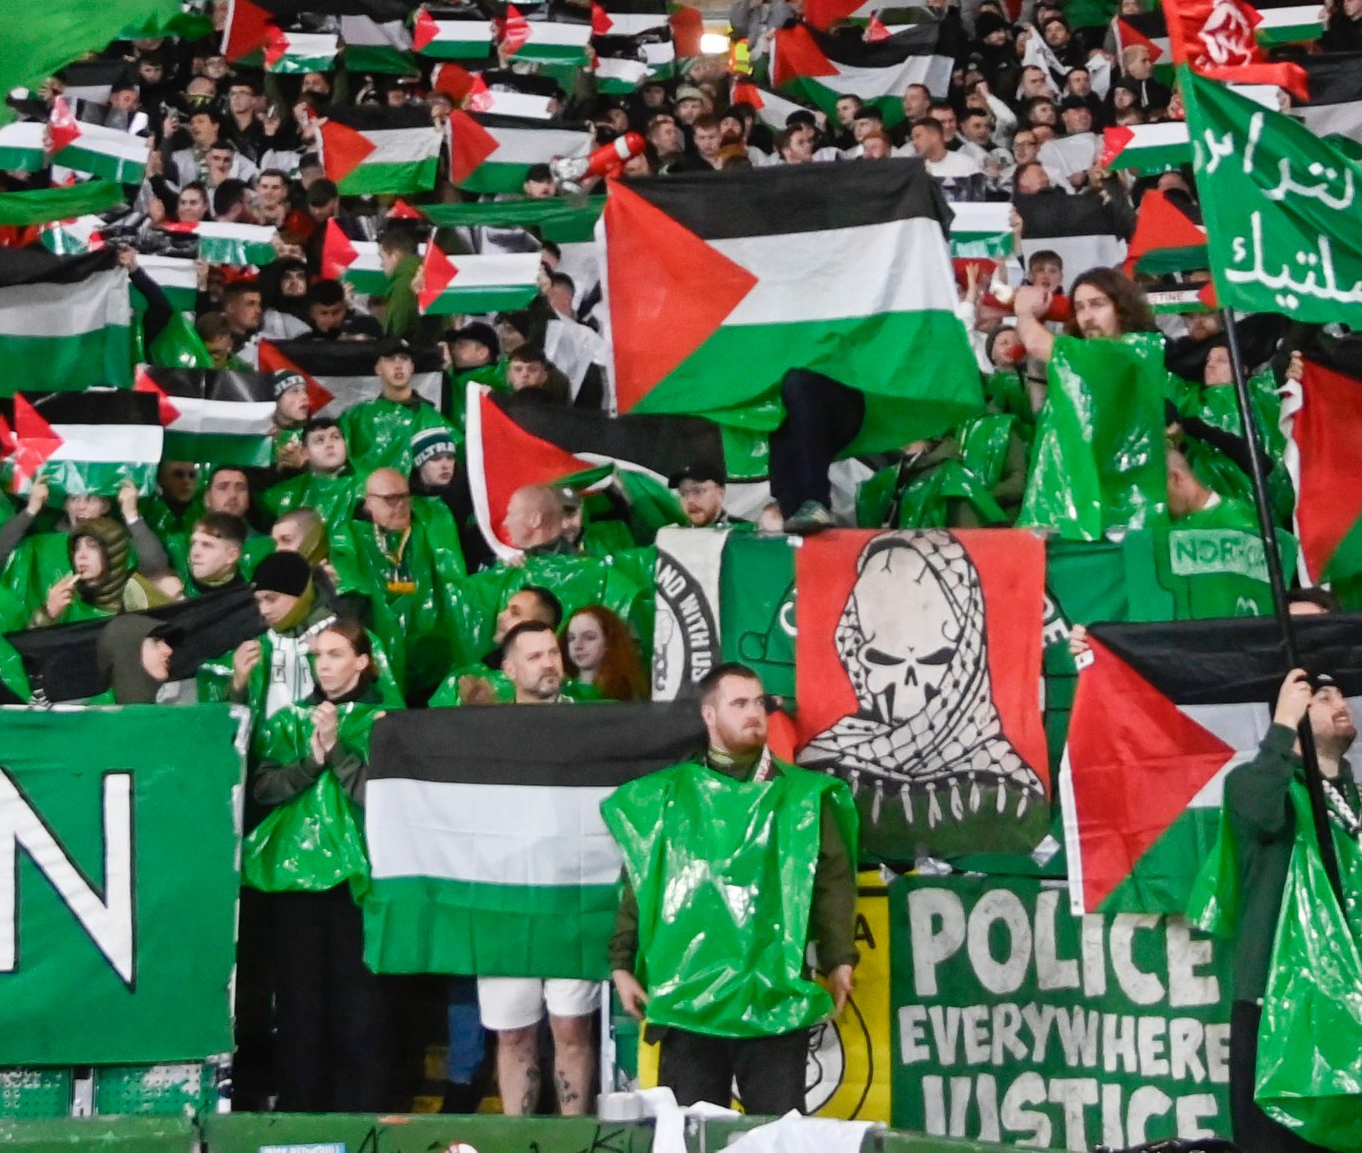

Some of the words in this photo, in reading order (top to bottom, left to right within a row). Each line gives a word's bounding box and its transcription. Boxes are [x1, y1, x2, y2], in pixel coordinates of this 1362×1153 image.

[679, 592, 710, 648] WITH
[907, 886, 1222, 1008] POLICE
[898, 1001, 1231, 1085] EVERYWHERE
